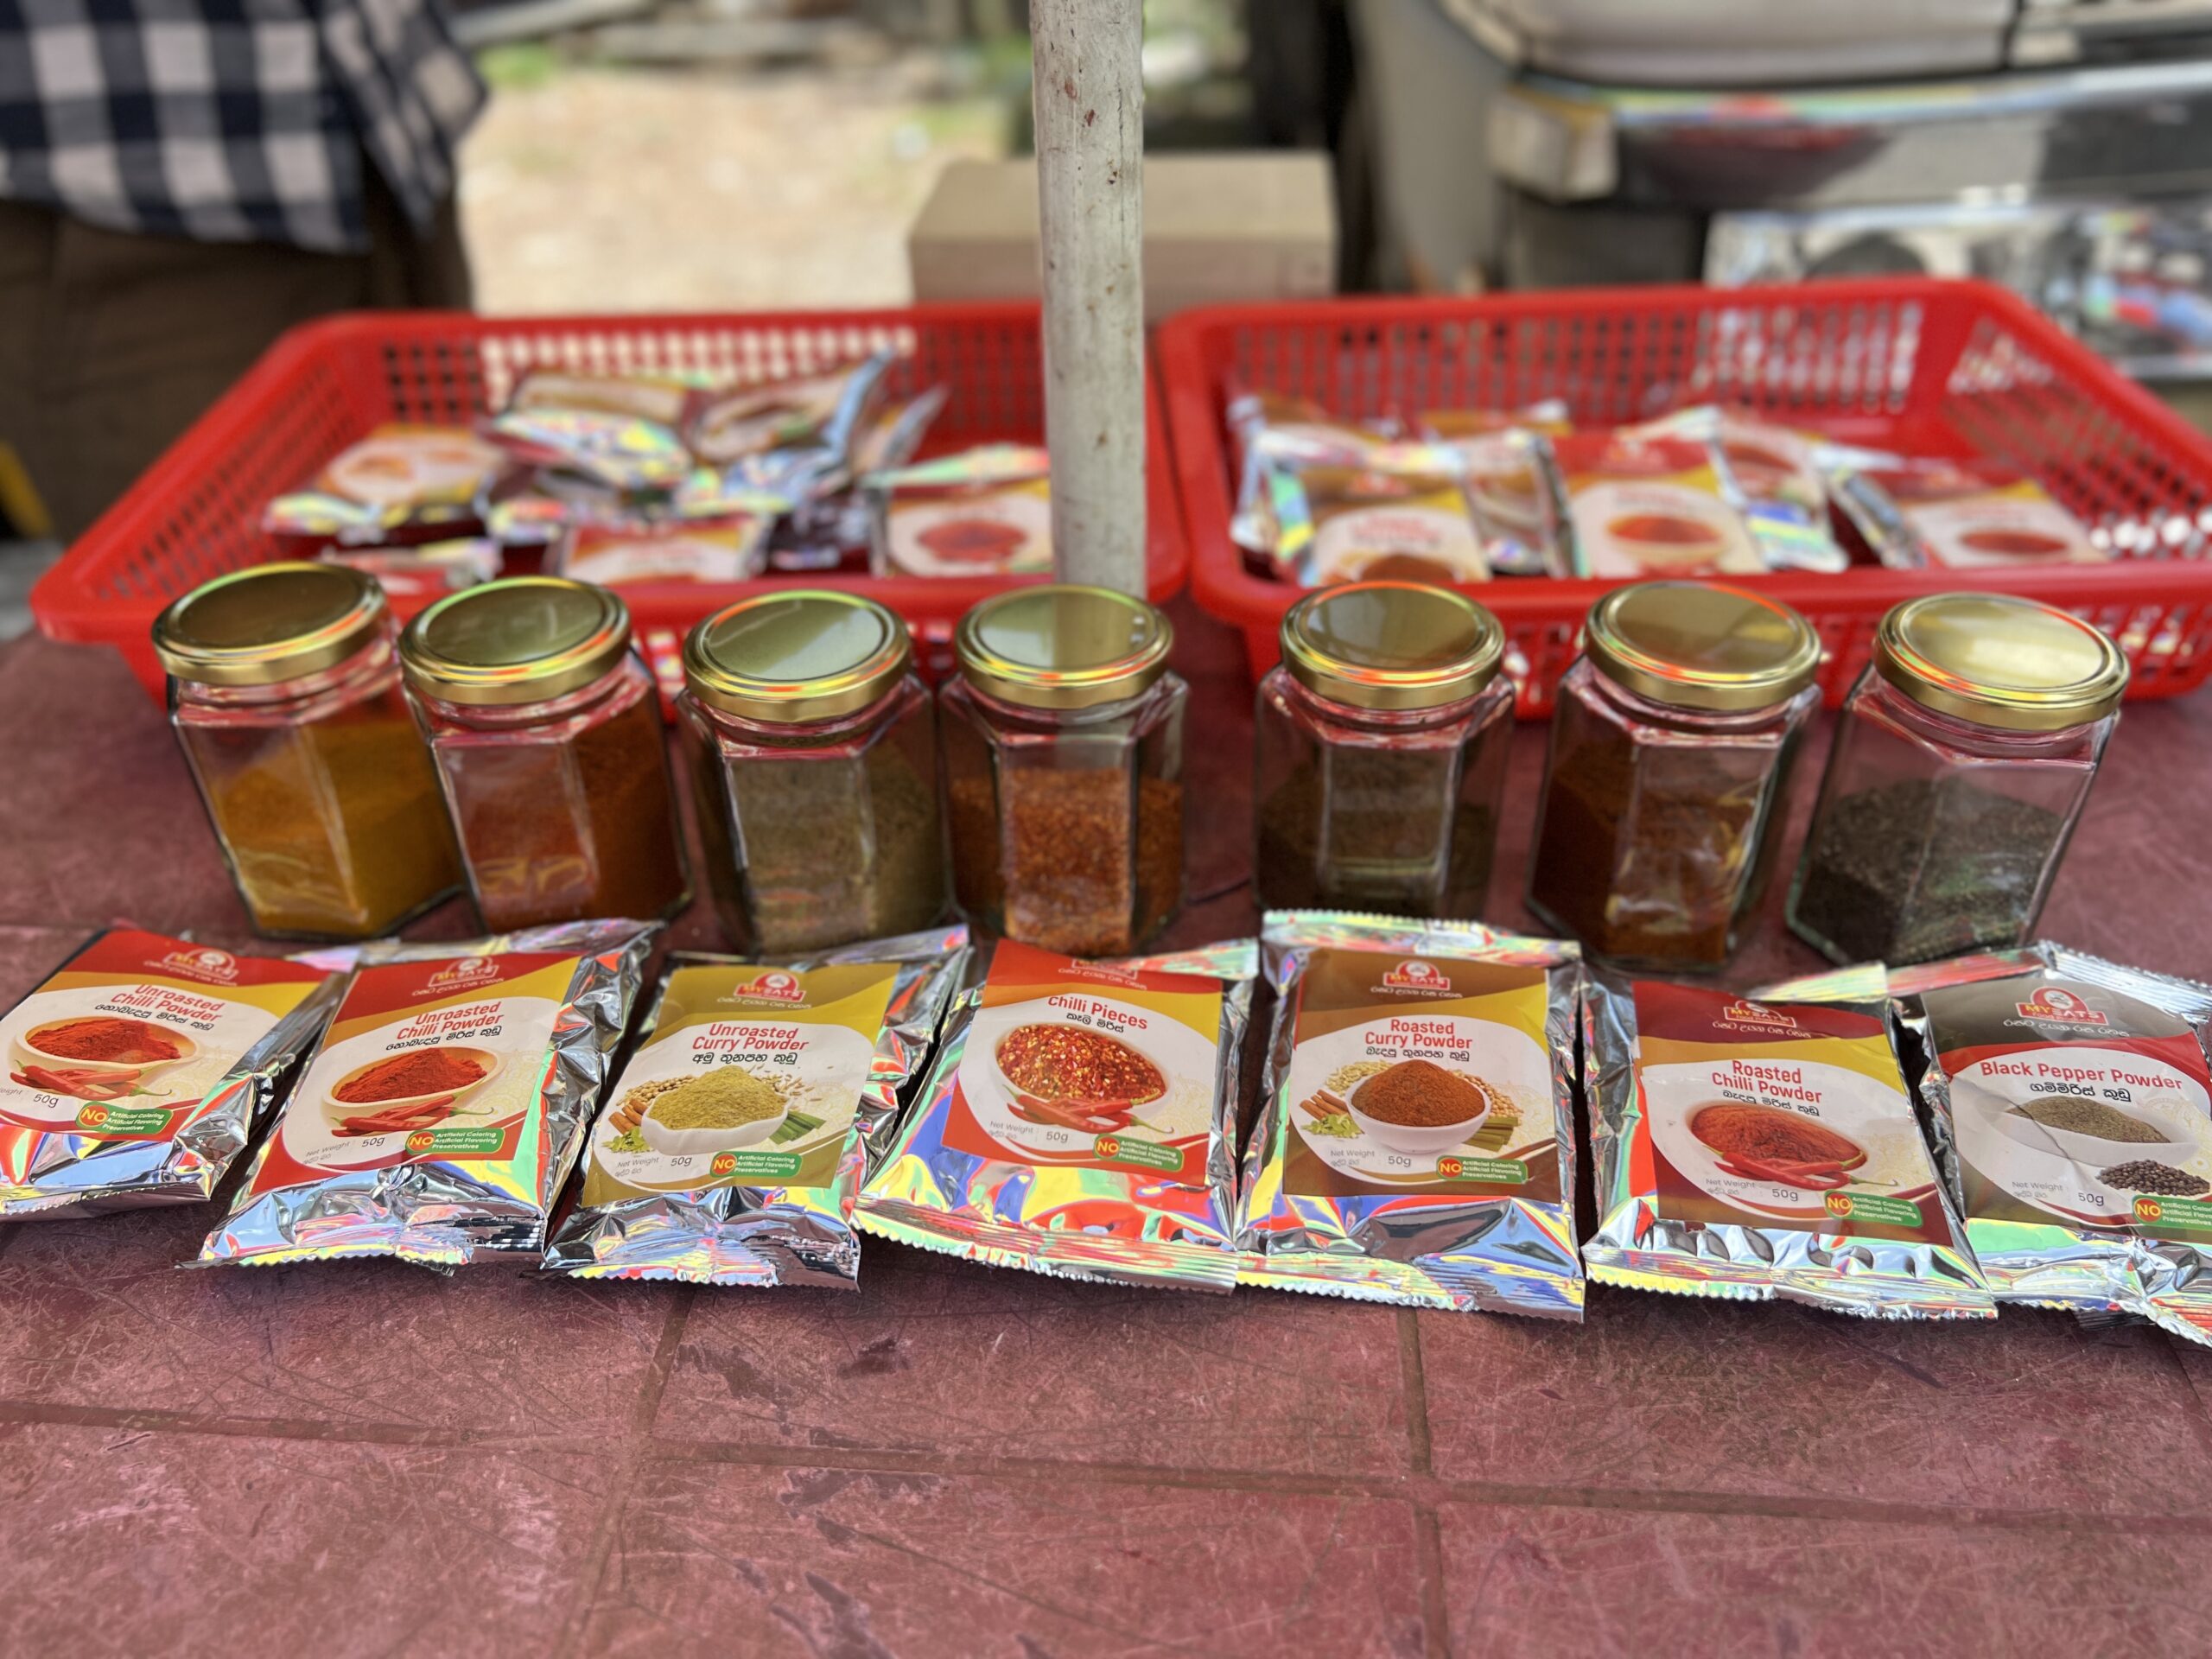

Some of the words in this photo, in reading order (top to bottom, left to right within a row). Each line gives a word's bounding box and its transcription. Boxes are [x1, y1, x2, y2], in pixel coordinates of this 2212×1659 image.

[135, 984, 225, 1011] Unroasted
[111, 994, 157, 1007] Chilli
[156, 1001, 222, 1021] Powder
[416, 1001, 501, 1025] Unroasted
[1048, 995, 1087, 1013] Chilli
[1090, 1002, 1147, 1030] Pieces
[397, 1021, 439, 1039] Chilli
[442, 1014, 505, 1033] Powder
[709, 1023, 798, 1039] Unroasted
[1391, 1019, 1454, 1035] Roasted
[693, 1036, 740, 1052] Curry
[743, 1037, 809, 1051] Powder
[1365, 1032, 1408, 1049] Curry
[1414, 1033, 1472, 1049] Powder
[1732, 1059, 1802, 1084] Roasted
[1980, 1061, 2032, 1077] Black
[2037, 1063, 2105, 1082] Pepper
[2111, 1068, 2183, 1090] Powder
[1712, 1071, 1753, 1091] Chilli
[1758, 1080, 1821, 1103] Powder
[0, 1087, 22, 1096] eight
[33, 1094, 59, 1108] 50g
[81, 1108, 107, 1122] NO
[361, 1137, 385, 1147] 50g
[410, 1137, 434, 1146] NO
[1046, 1130, 1069, 1142] 50g
[1096, 1142, 1120, 1153] NO
[671, 1156, 692, 1166] 50g
[714, 1159, 736, 1170] NO
[1388, 1156, 1411, 1167] 50g
[1440, 1163, 1462, 1173] NO
[1771, 1187, 1799, 1201] 50g
[2078, 1192, 2105, 1206] 50g
[1827, 1198, 1851, 1209] NO
[2136, 1204, 2160, 1217] NO
